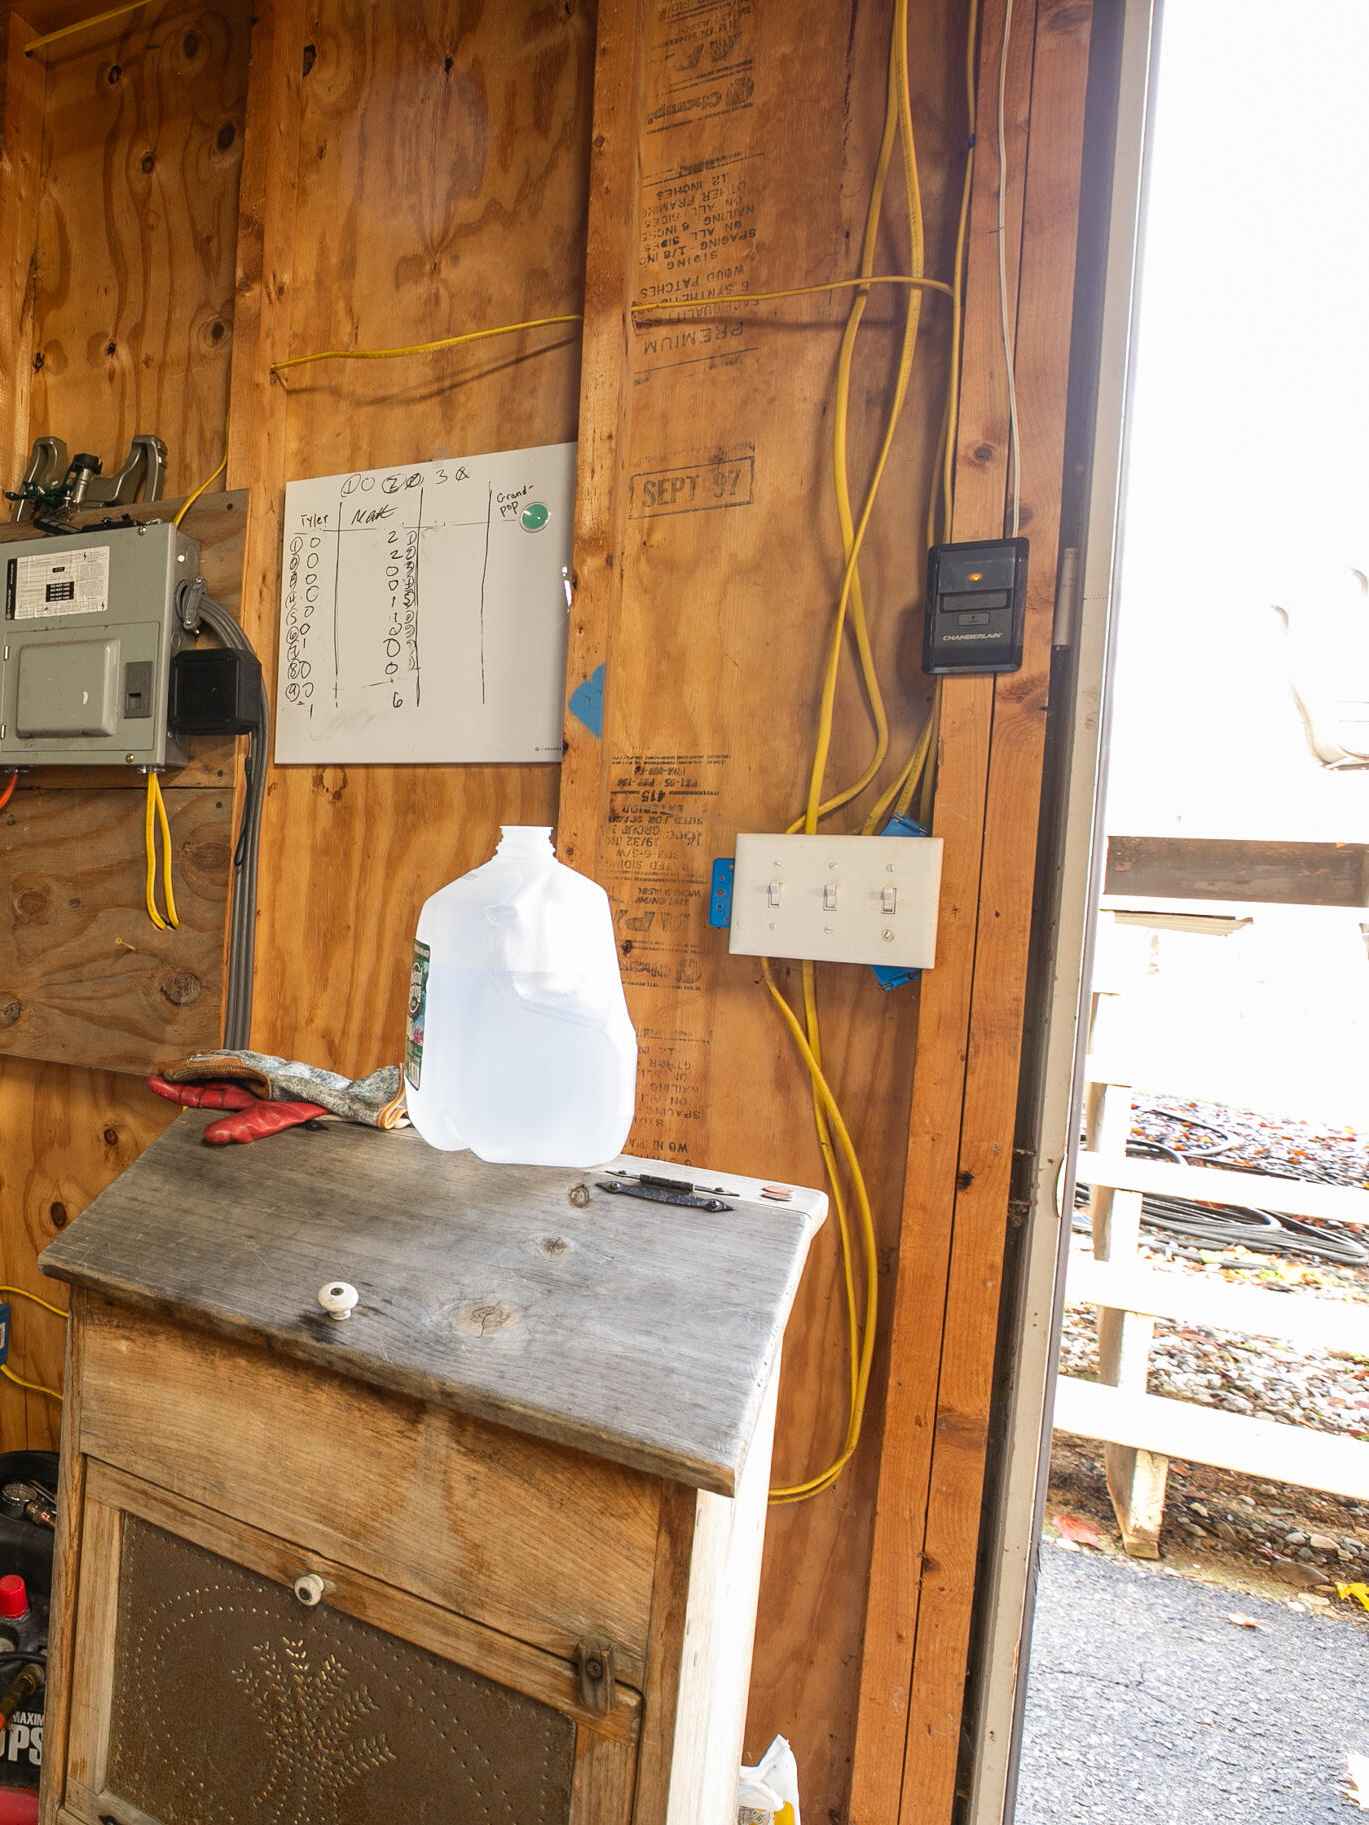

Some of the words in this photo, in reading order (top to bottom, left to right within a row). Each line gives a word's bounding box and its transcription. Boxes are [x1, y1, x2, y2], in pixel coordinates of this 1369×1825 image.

[656, 181, 702, 200] INCHES
[691, 202, 715, 216] ALL
[703, 204, 754, 226] NAILING
[691, 227, 715, 240] ALL
[667, 251, 718, 269] SIDING
[707, 265, 744, 282] WOOD
[640, 276, 699, 298] PATCHES
[643, 321, 743, 355] PREMIUM
[436, 469, 448, 484] 3
[643, 475, 699, 508] SEPT
[301, 513, 328, 528] Tyler
[388, 531, 398, 543] 2
[390, 550, 403, 559] 2
[943, 632, 1003, 641] CHAMBERLAIN
[393, 692, 403, 708] 6
[641, 790, 666, 802] 415
